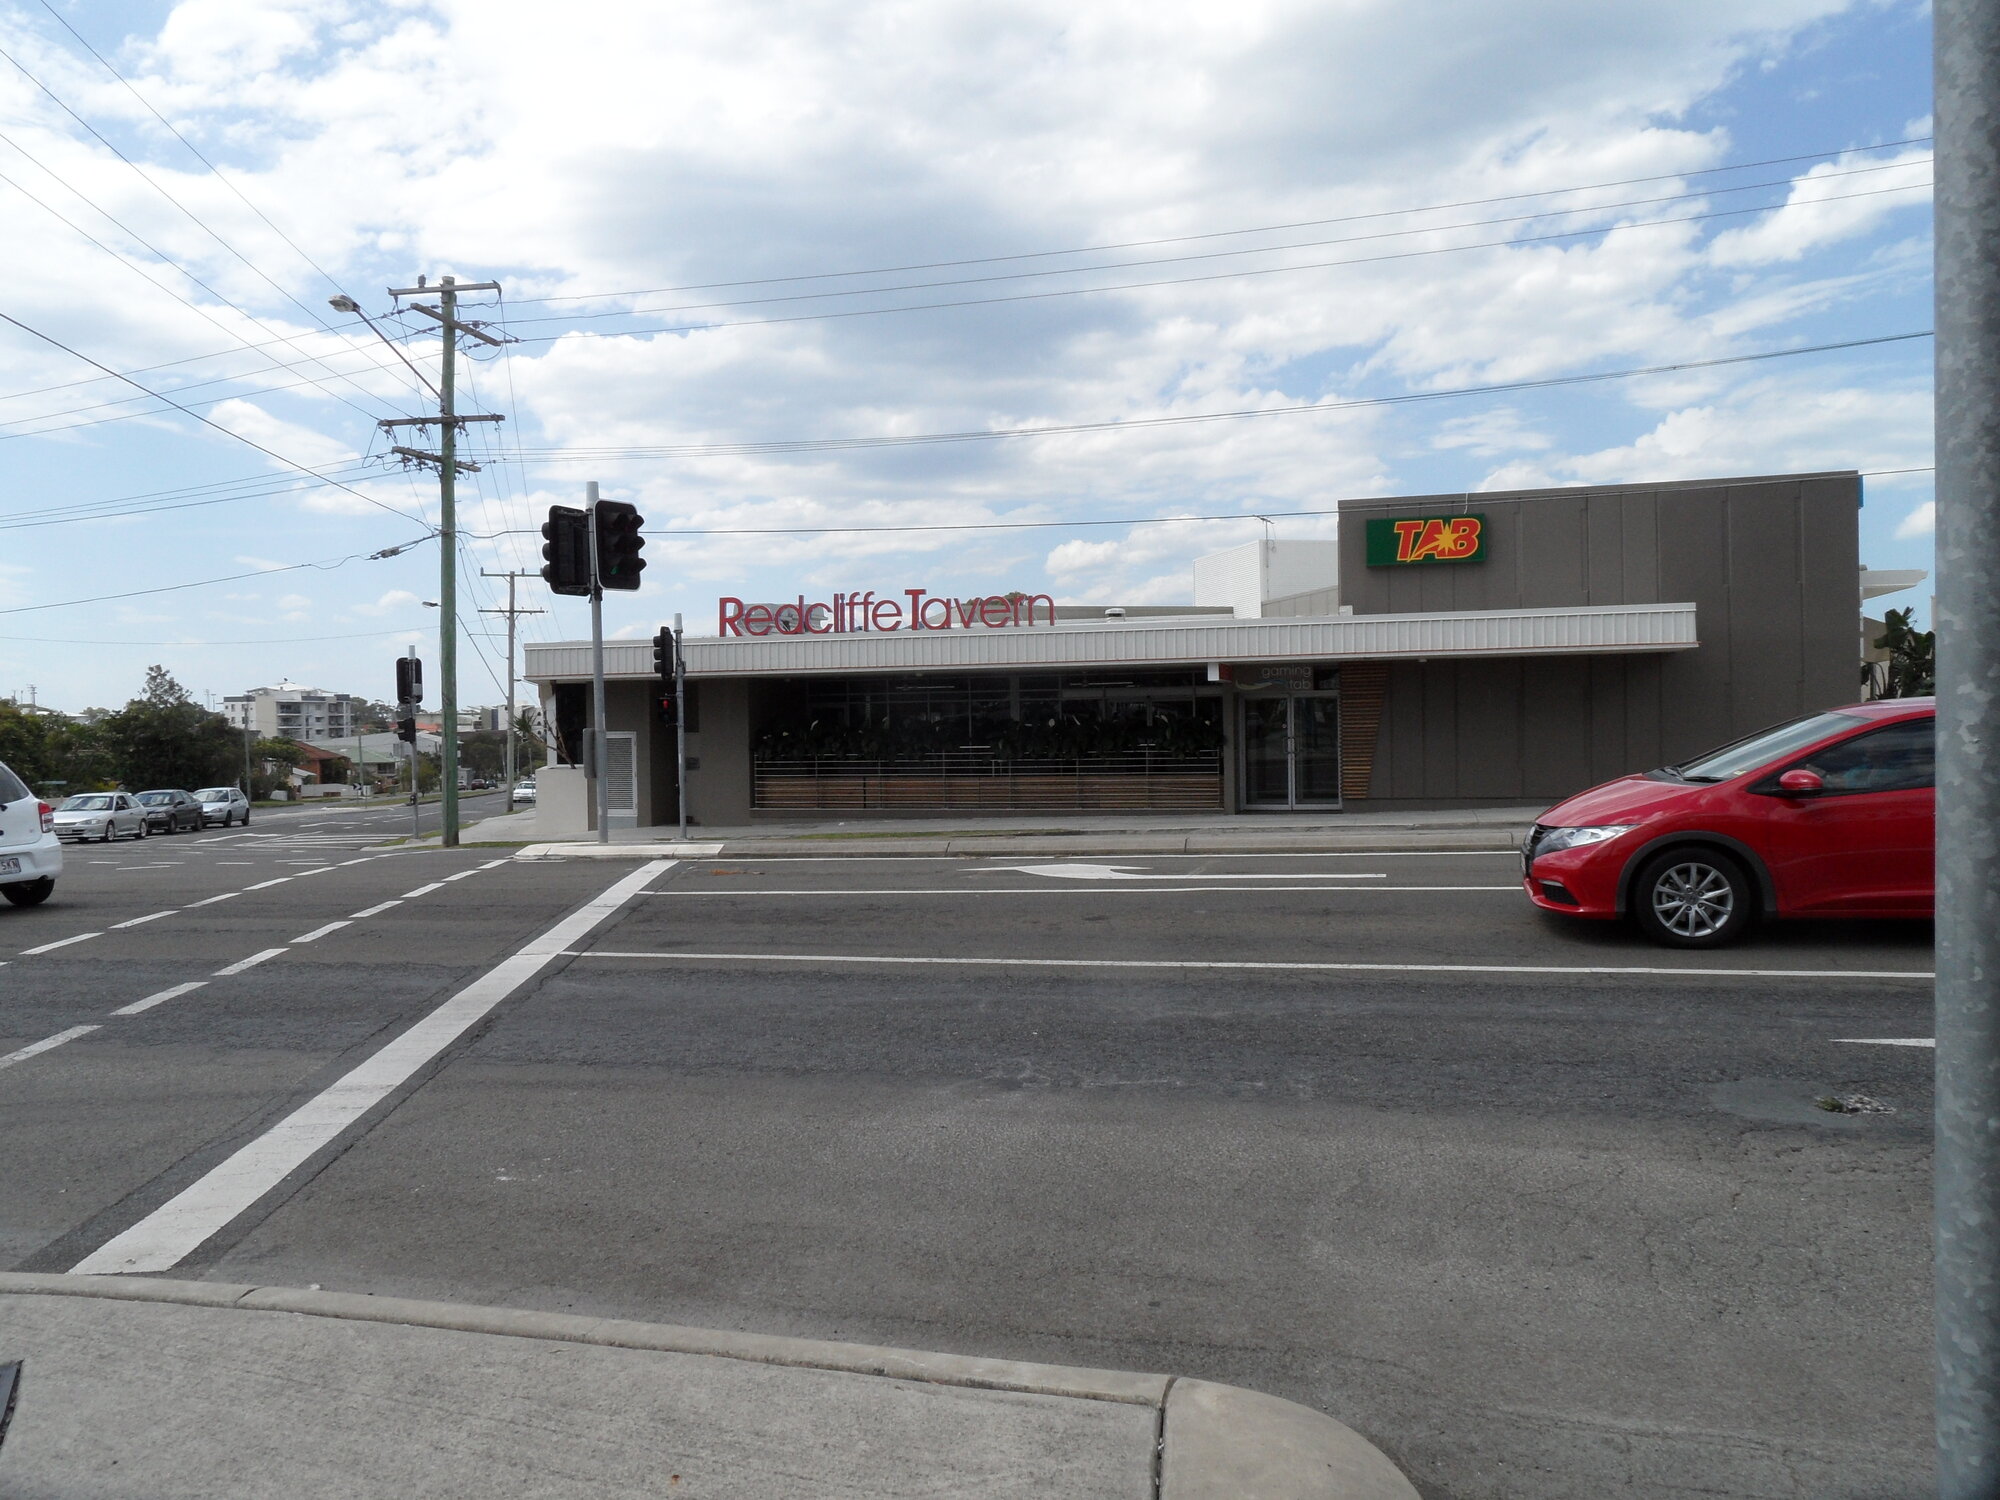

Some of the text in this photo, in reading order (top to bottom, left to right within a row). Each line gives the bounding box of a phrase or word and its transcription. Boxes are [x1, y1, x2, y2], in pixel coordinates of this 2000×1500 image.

[1394, 518, 1481, 562] TAB
[1262, 665, 1312, 678] gaming
[1288, 679, 1312, 690] tab
